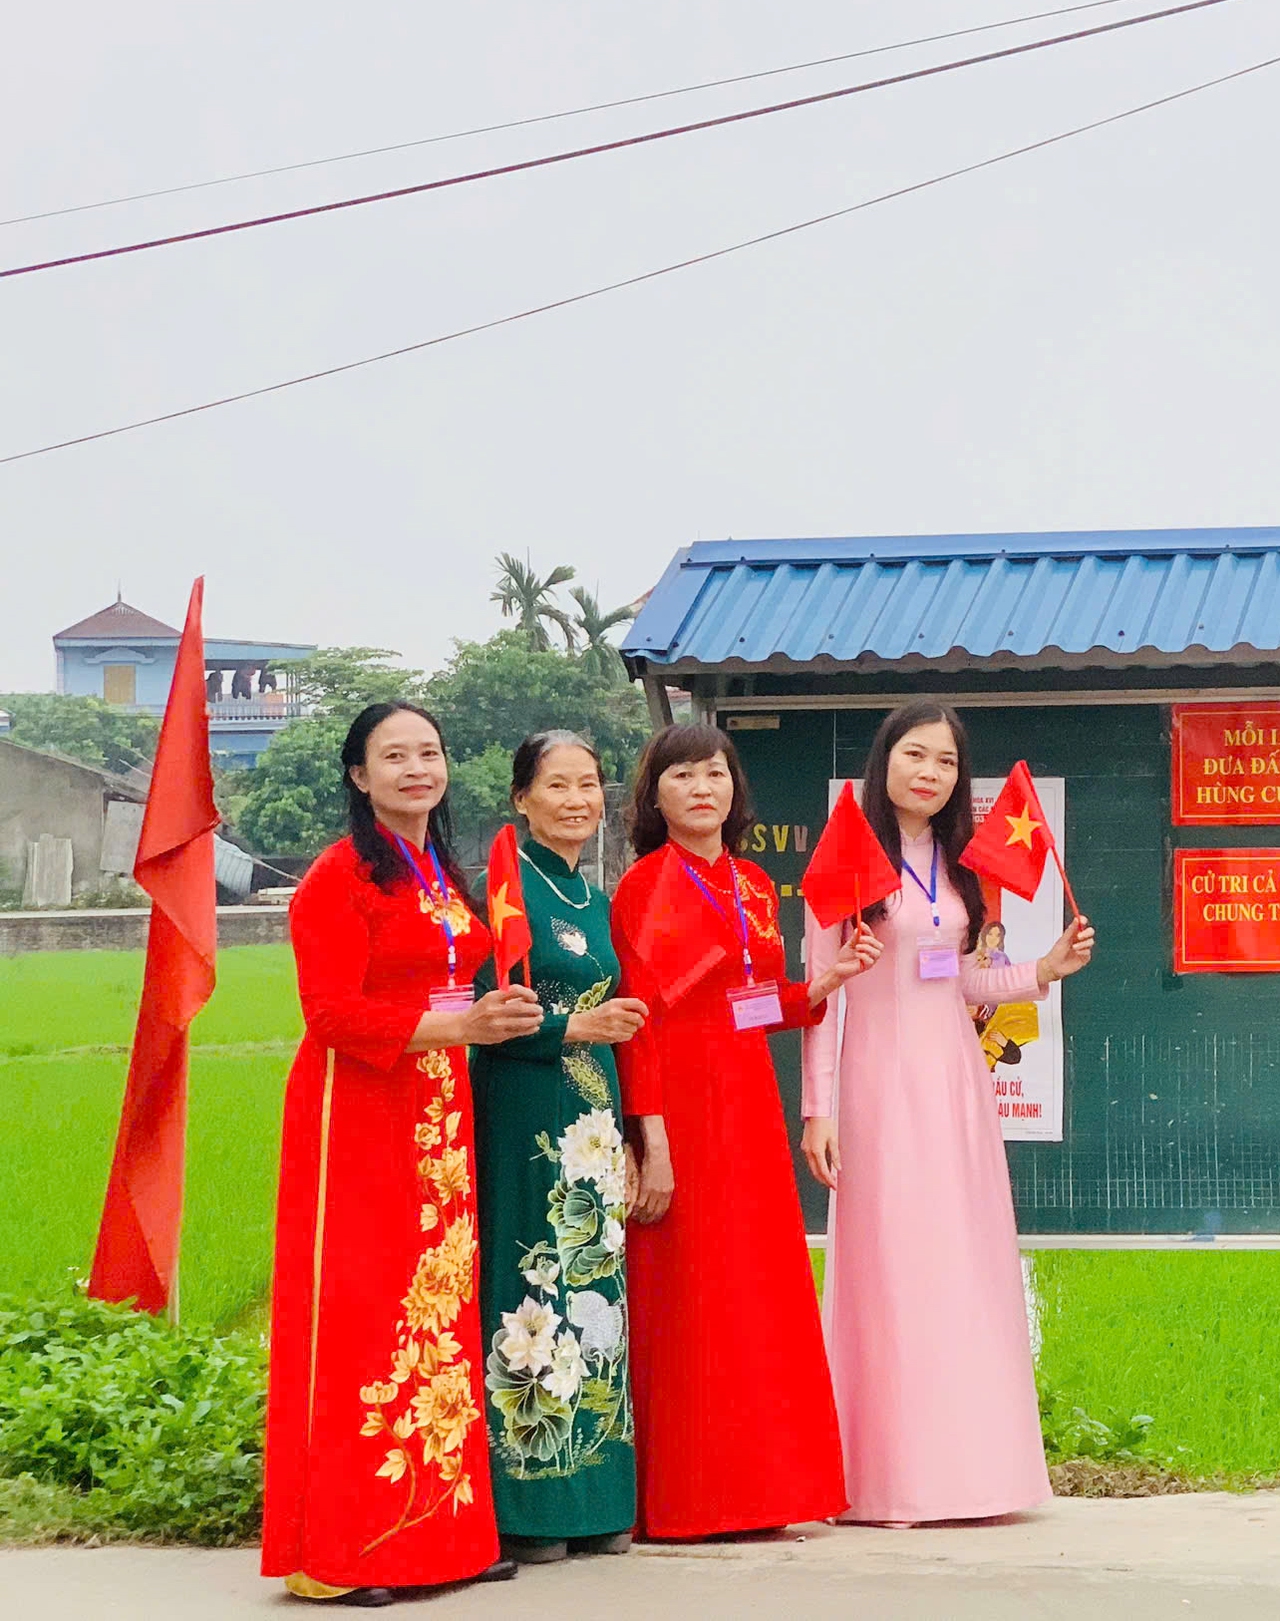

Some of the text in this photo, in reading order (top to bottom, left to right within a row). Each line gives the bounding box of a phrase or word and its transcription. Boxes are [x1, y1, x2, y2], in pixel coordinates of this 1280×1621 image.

[1224, 720, 1264, 746] MỖI
[1203, 755, 1245, 775] ĐƯA
[1196, 782, 1255, 804] HÙNG
[1191, 870, 1215, 894] CỬ
[1218, 875, 1249, 893] TRI
[1252, 869, 1277, 893] CẢ
[1203, 902, 1264, 921] CHUNG
